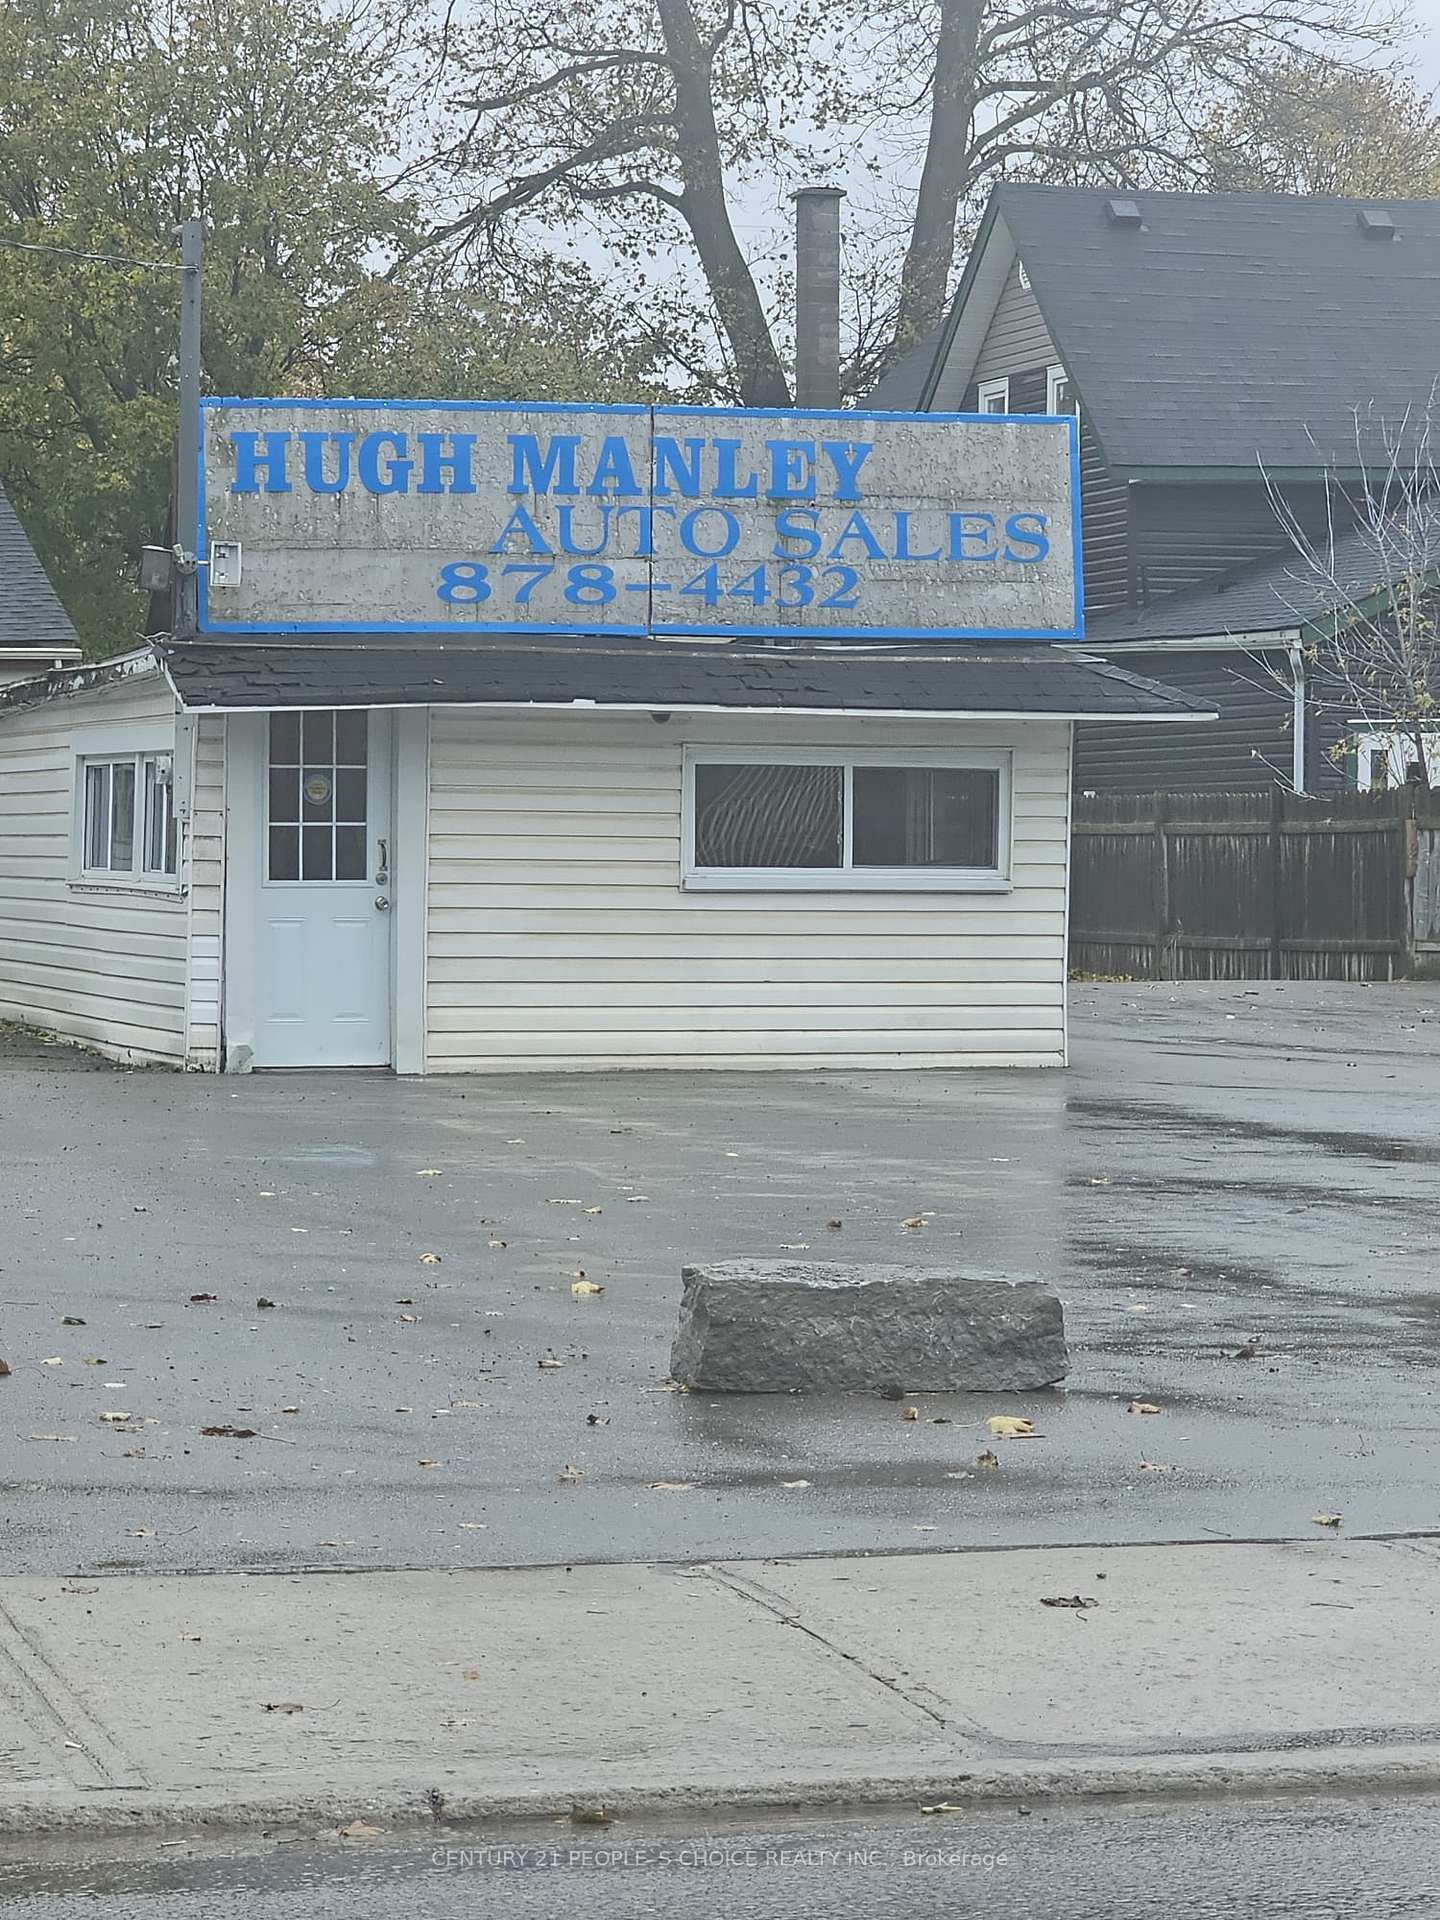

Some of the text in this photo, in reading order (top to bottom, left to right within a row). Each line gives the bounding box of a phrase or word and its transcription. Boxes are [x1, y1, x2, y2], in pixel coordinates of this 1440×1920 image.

[230, 431, 875, 501] HUGH MANLEY
[488, 503, 1051, 563] AUTO SALES
[436, 561, 861, 609] 878-4432
